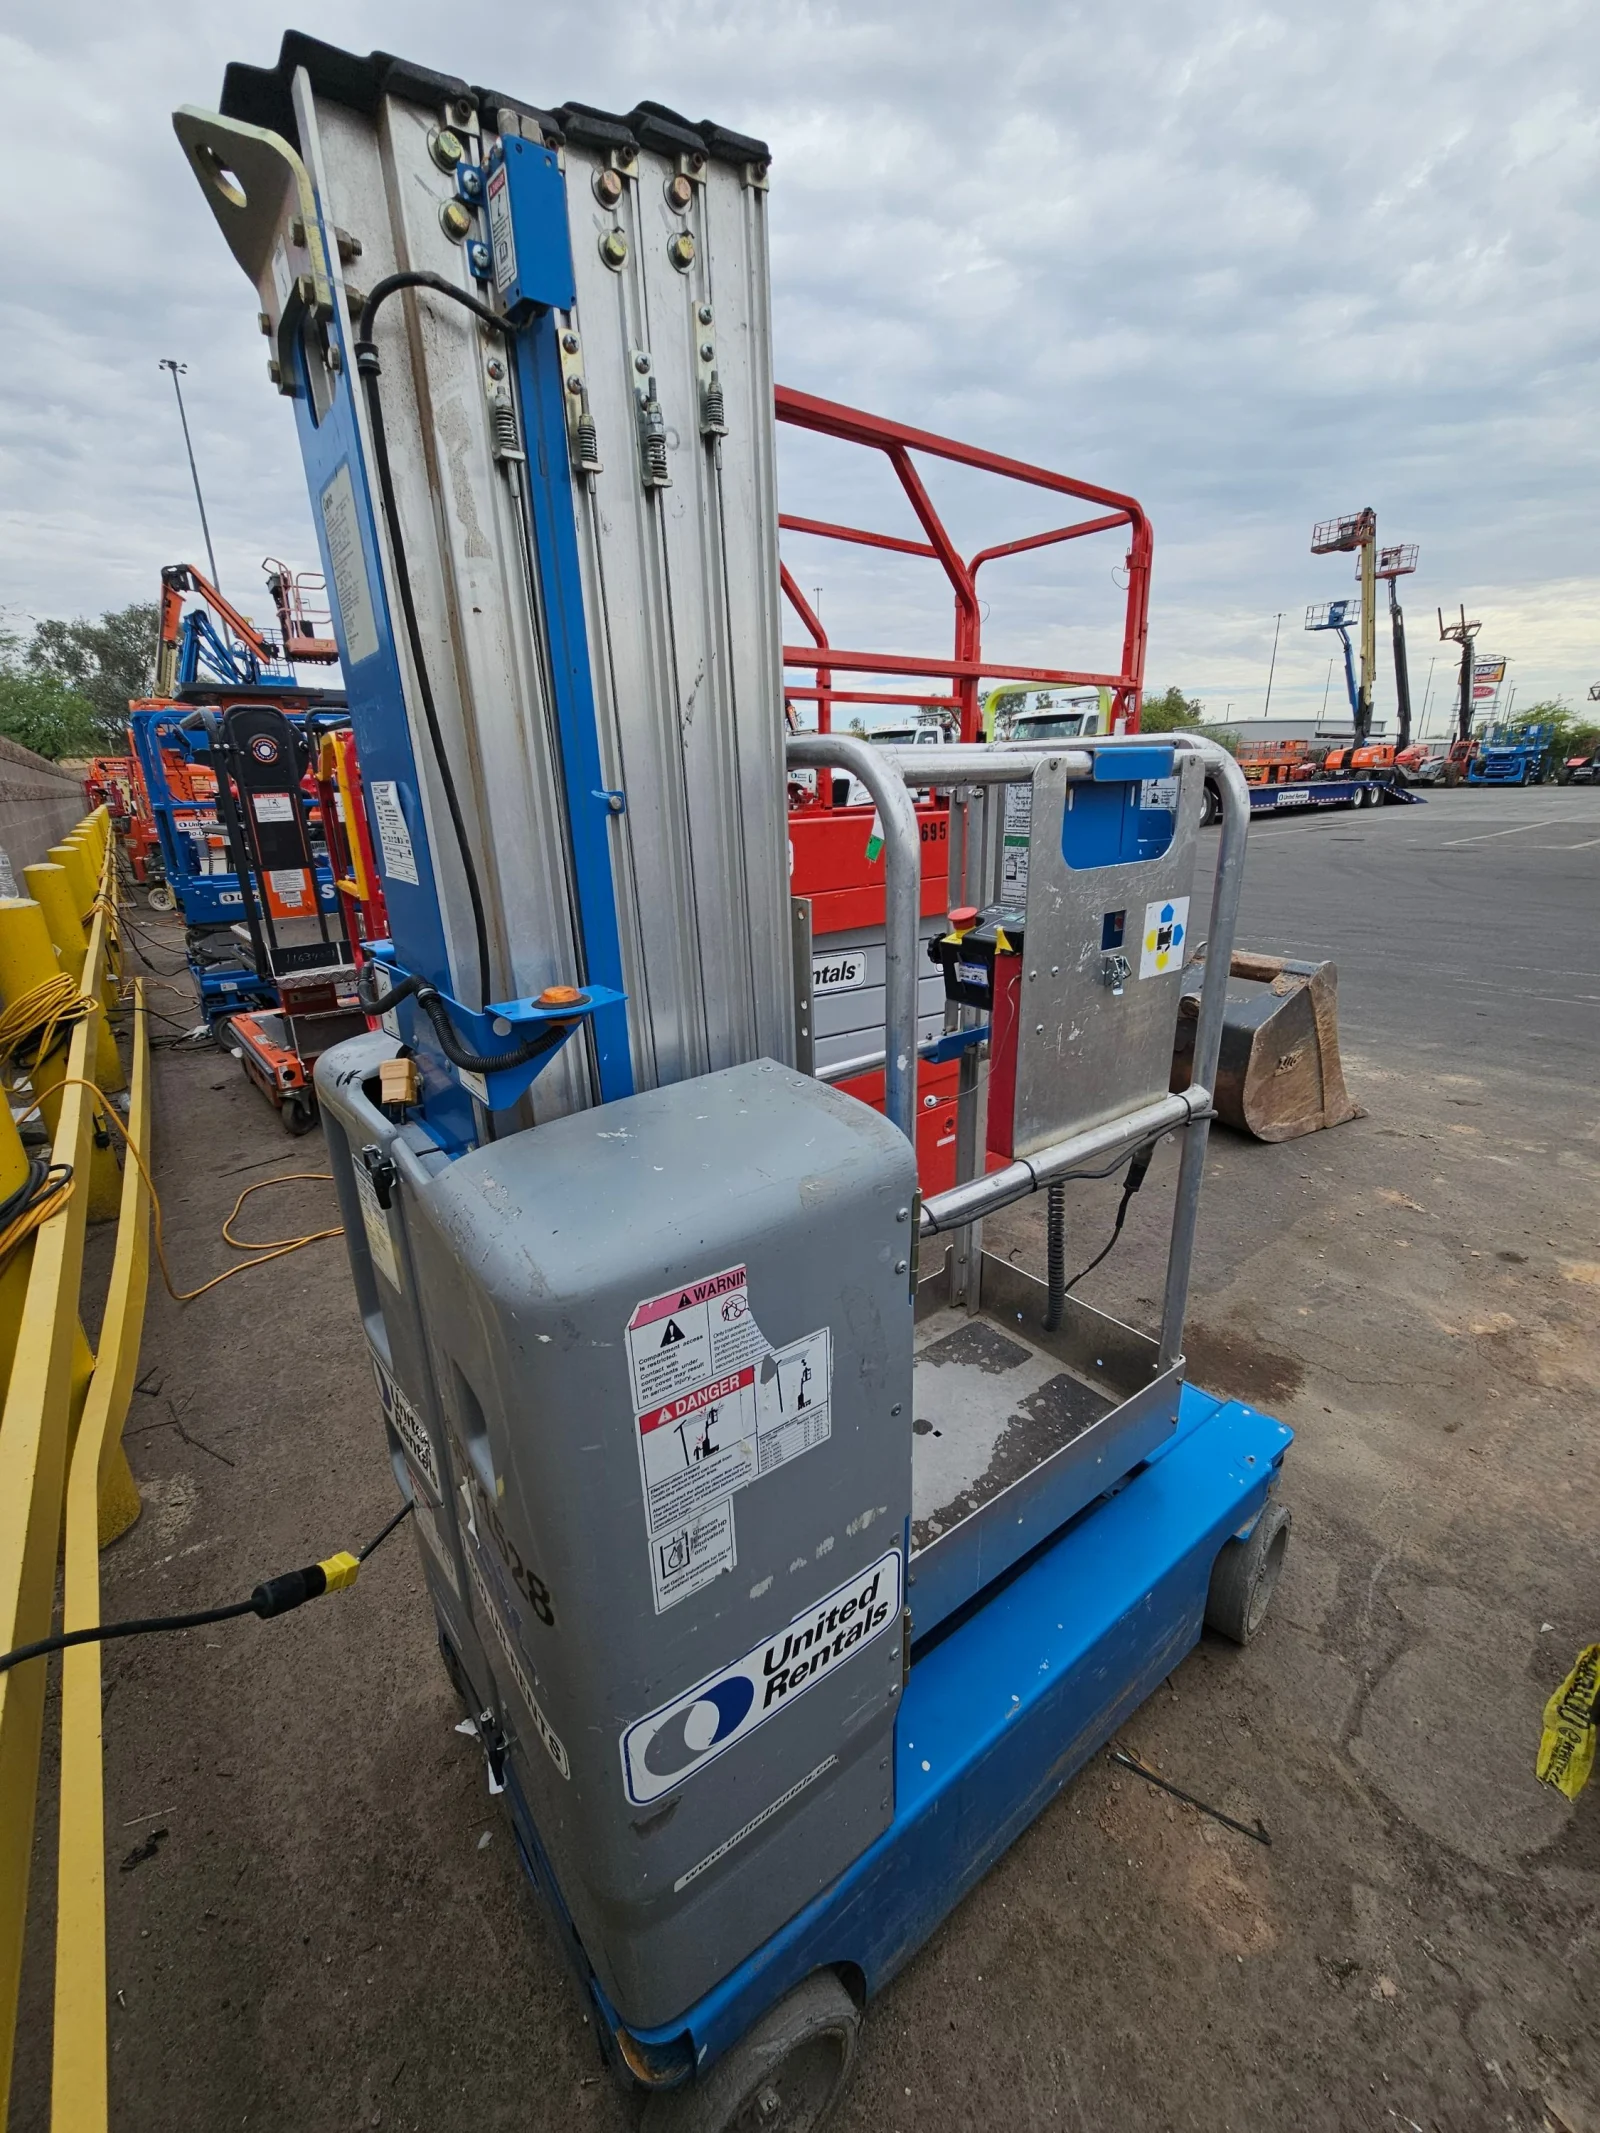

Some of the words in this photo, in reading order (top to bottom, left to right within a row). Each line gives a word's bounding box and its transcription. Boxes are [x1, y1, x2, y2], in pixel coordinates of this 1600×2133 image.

[922, 821, 947, 842] 695
[639, 1344, 680, 1365] Compartment
[683, 1335, 703, 1346] access
[647, 1353, 676, 1368] restricted.
[640, 1366, 664, 1380] Contact
[641, 1368, 678, 1386] components
[651, 1384, 672, 1396] serious
[676, 1374, 740, 1416] DANGER
[693, 1528, 725, 1549] equivalent
[694, 1545, 708, 1555] only
[664, 1576, 689, 1595] equivalent
[762, 1572, 880, 1678] United
[762, 1600, 888, 1710] Rentals
